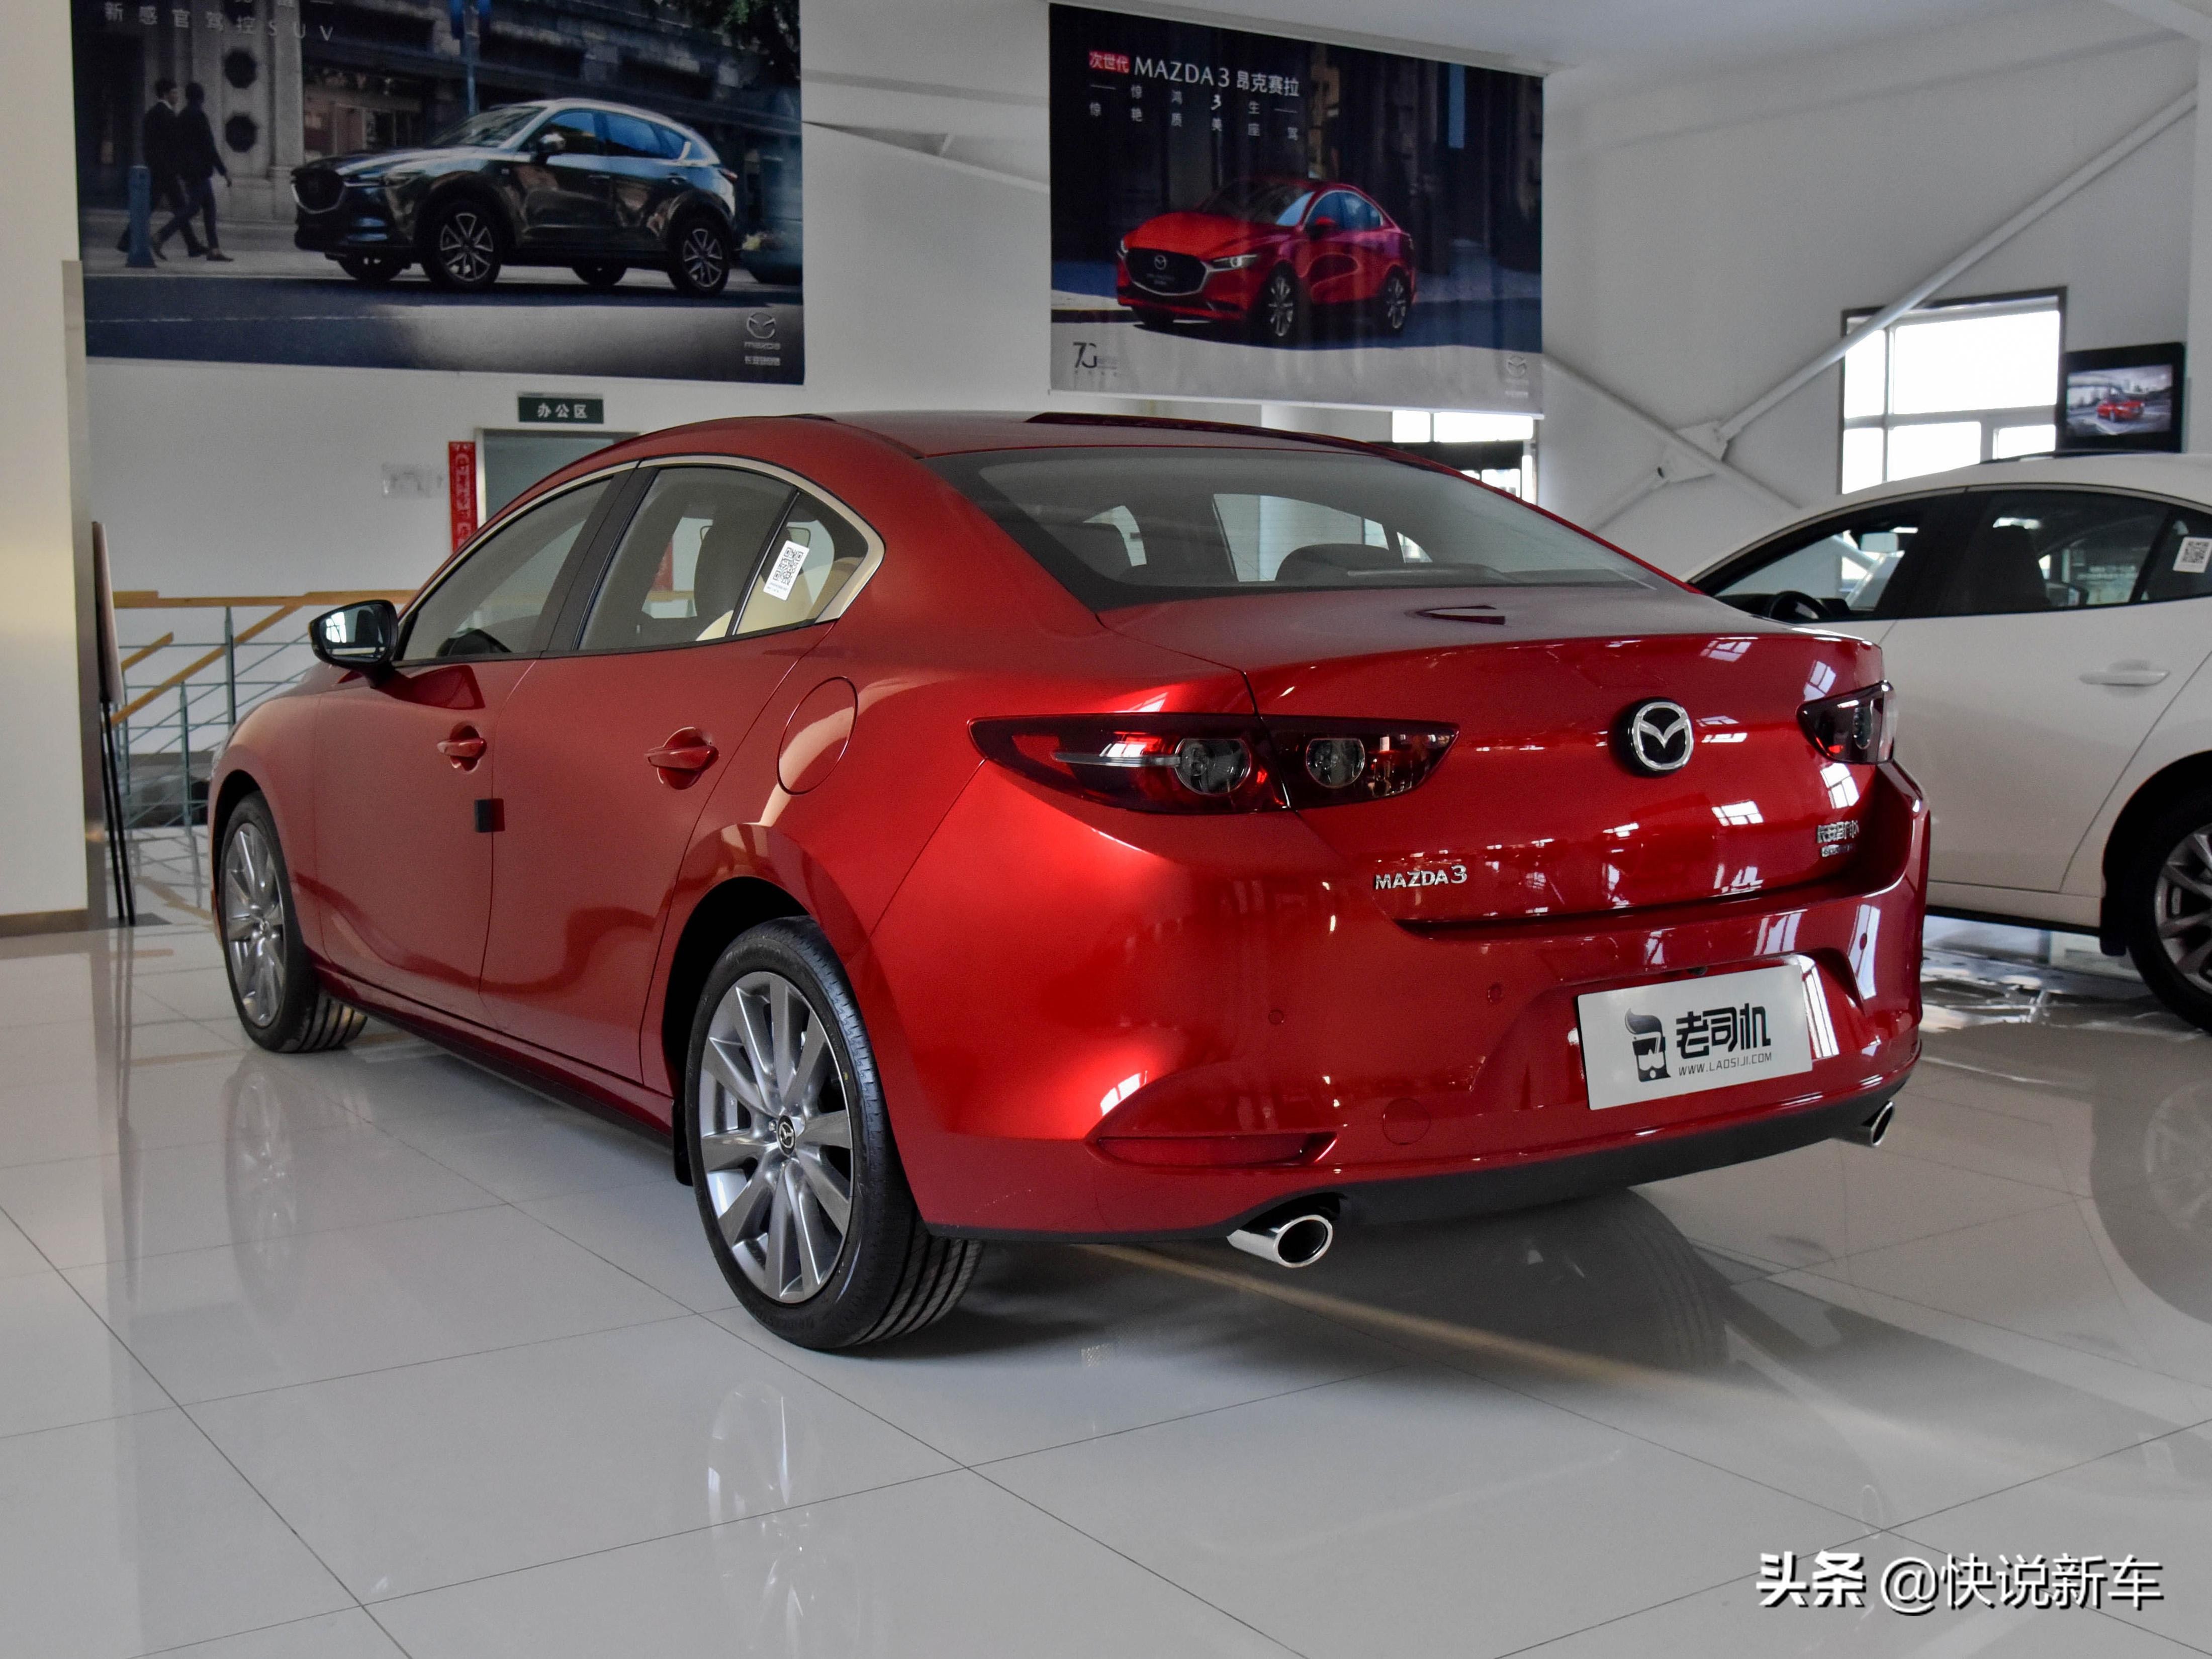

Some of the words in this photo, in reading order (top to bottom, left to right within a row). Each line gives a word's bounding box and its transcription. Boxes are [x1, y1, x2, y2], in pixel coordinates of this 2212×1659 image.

[1089, 52, 1130, 74] 次世代
[1237, 70, 1300, 97] 昂克赛拉
[537, 403, 587, 418] 办公区
[1375, 865, 1467, 890] MAZDA3
[1676, 1003, 1771, 1059] 老司机
[1678, 1052, 1772, 1076] WWW.LAOSIJI.COM
